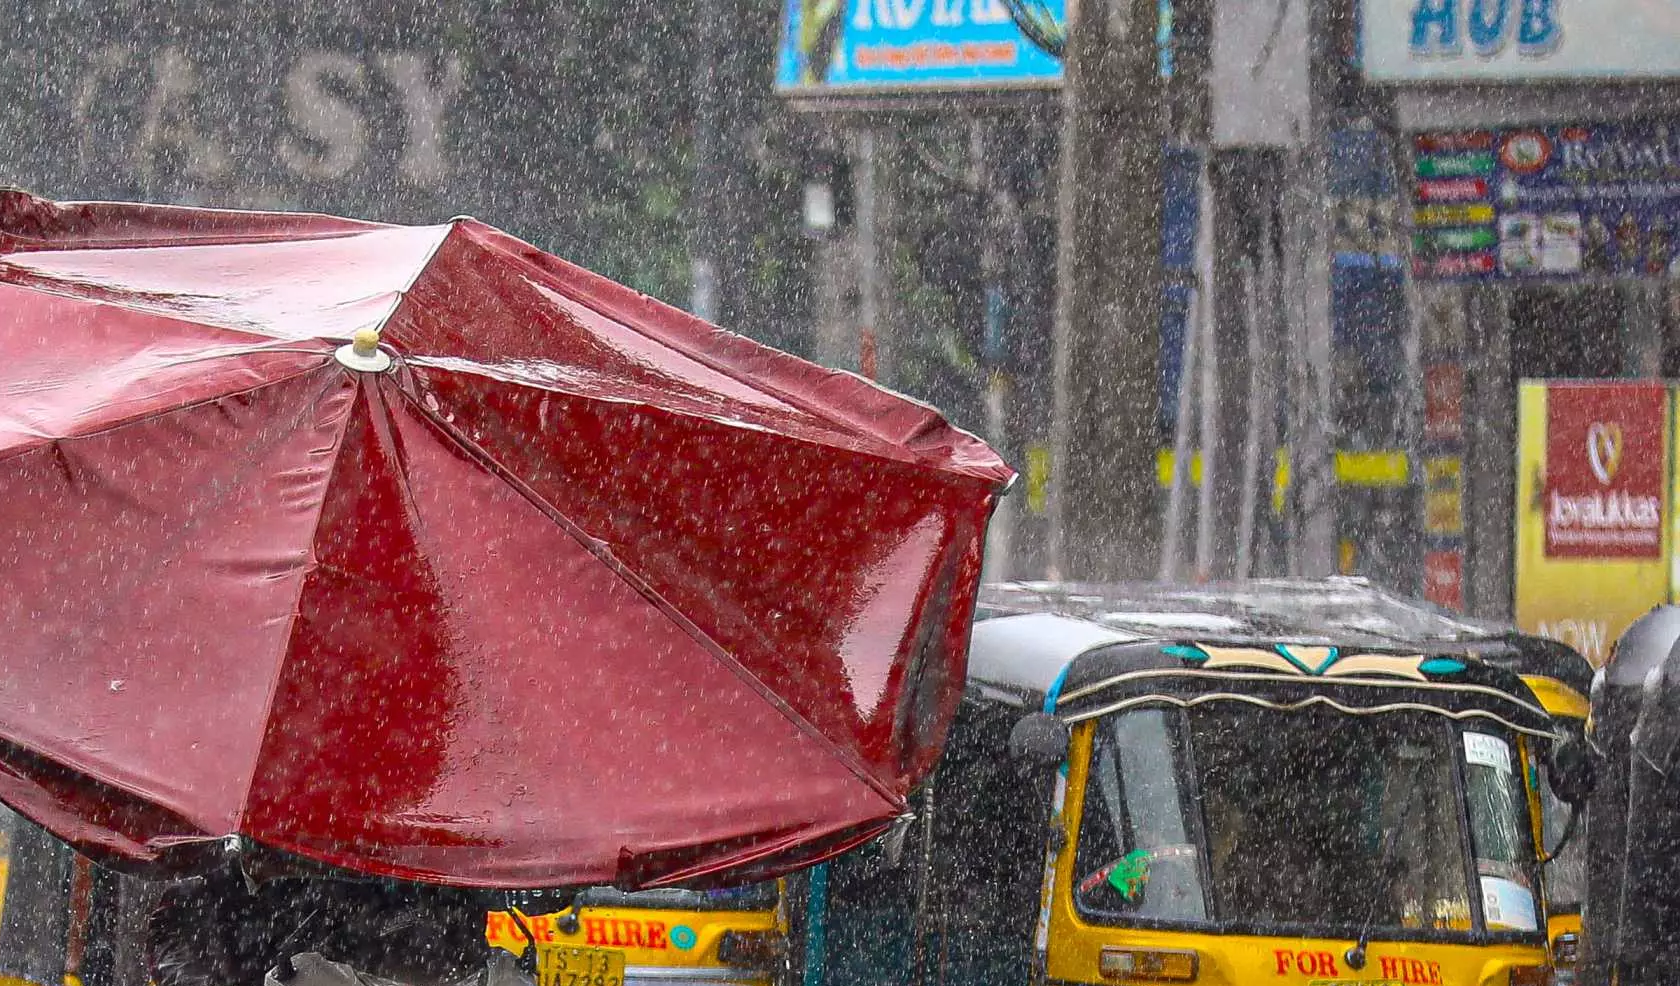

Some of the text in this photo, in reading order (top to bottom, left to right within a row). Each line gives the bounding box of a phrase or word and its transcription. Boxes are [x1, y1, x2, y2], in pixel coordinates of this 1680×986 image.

[486, 914, 667, 949] FOR HIRE
[1274, 948, 1442, 986] FOR HIRE
